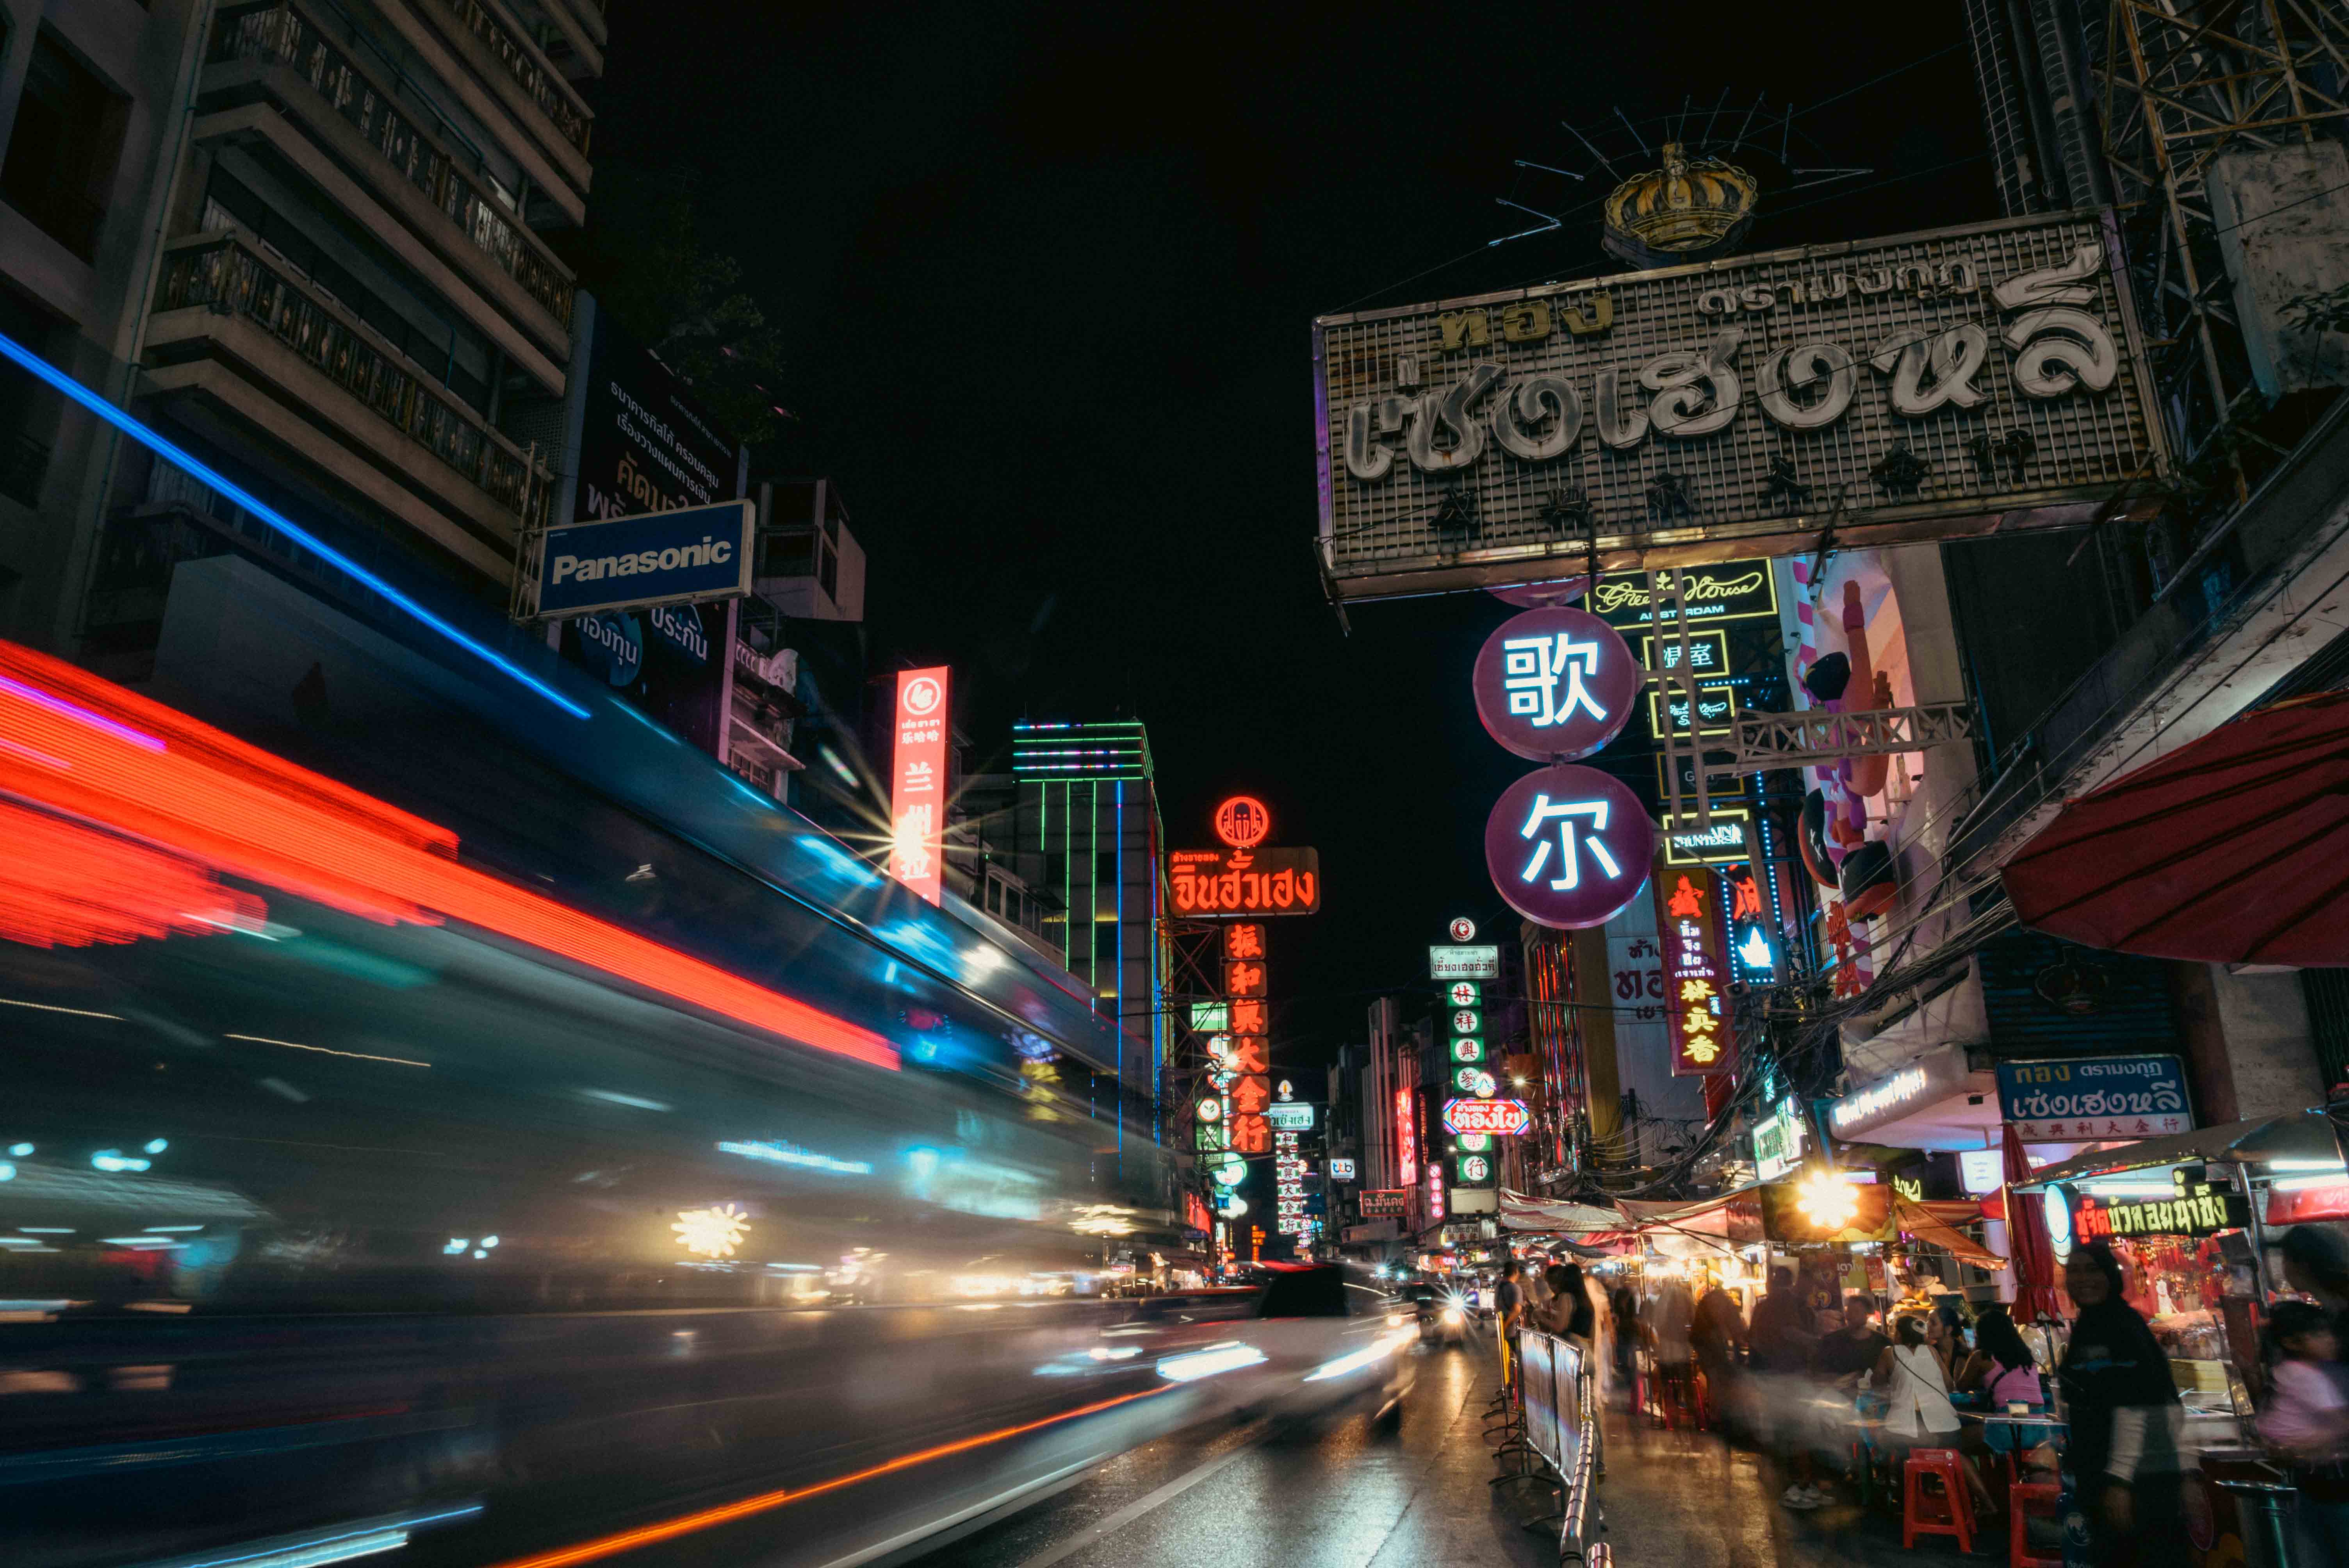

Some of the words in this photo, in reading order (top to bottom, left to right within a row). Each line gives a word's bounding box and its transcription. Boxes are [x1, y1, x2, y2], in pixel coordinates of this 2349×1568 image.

[1438, 291, 1615, 351] ทอง
[611, 381, 674, 446] ธนาคารทิสโก้
[675, 442, 719, 488] ครอบคลุม
[552, 536, 731, 584] Panasonic
[1682, 572, 1762, 601] House
[1640, 605, 1724, 621] ASTRDAM
[1504, 633, 1621, 891] 歌尔
[1171, 850, 1315, 910] จินฮั้วเฮง
[2015, 1065, 2071, 1084] ทอง
[2013, 1080, 2181, 1117] เซ่งเฮงหลี
[1333, 1162, 1352, 1173] ttb
